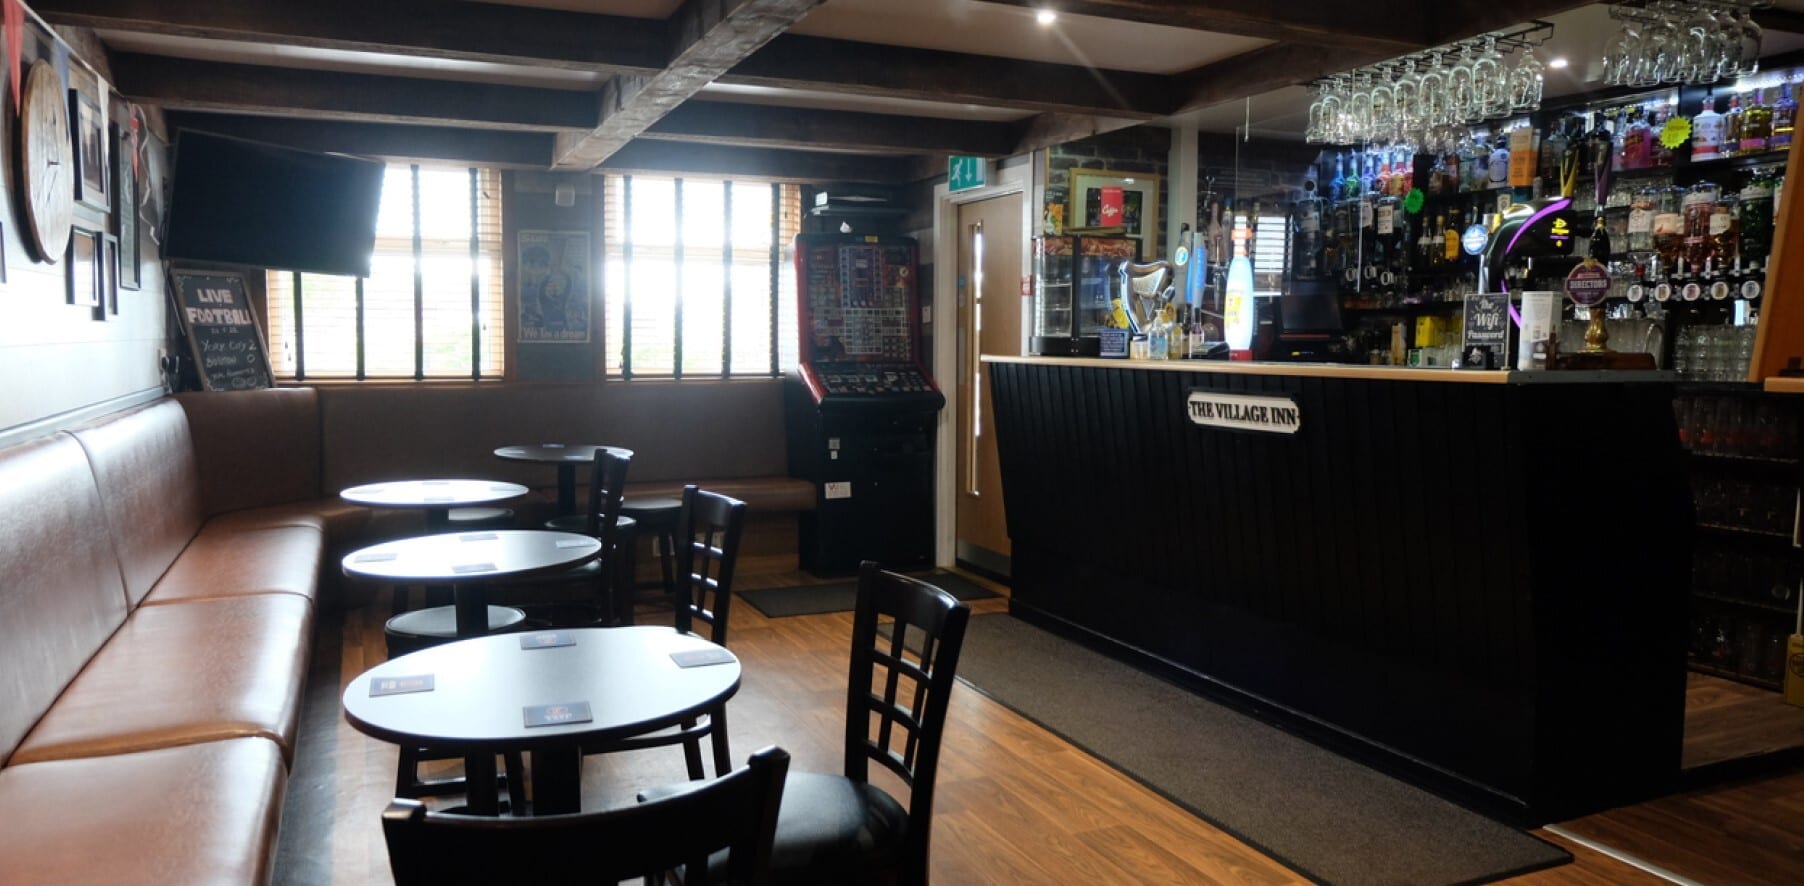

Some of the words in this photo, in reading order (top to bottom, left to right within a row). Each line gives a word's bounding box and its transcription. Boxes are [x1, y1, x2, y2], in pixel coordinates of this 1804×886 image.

[197, 289, 233, 304] LIVE
[185, 307, 252, 325] FOOTBALL
[1473, 313, 1499, 330] Wifi
[1189, 401, 1214, 418] THE
[1215, 403, 1268, 423] VILLAGE
[1270, 407, 1296, 425] INN
